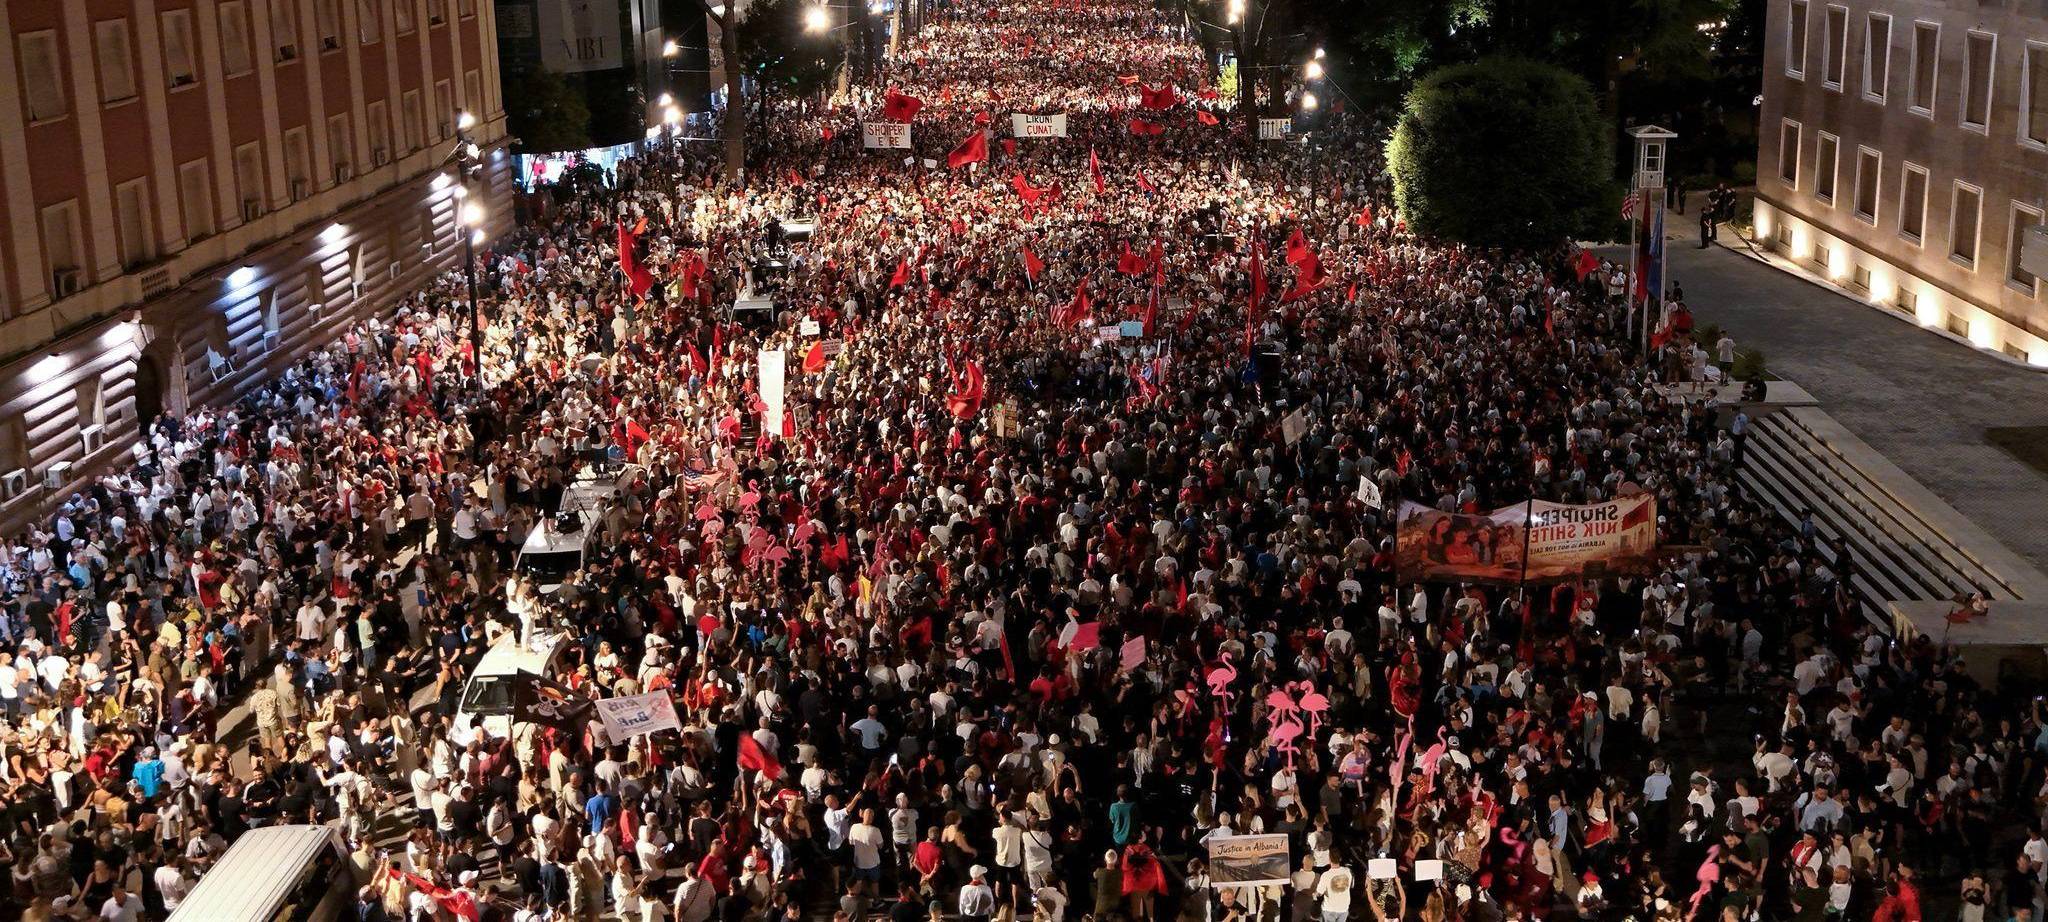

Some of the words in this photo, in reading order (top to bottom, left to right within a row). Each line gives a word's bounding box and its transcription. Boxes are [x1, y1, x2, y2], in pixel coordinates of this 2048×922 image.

[878, 136, 884, 146] E
[889, 136, 900, 147] RE
[1217, 844, 1243, 855] Justice
